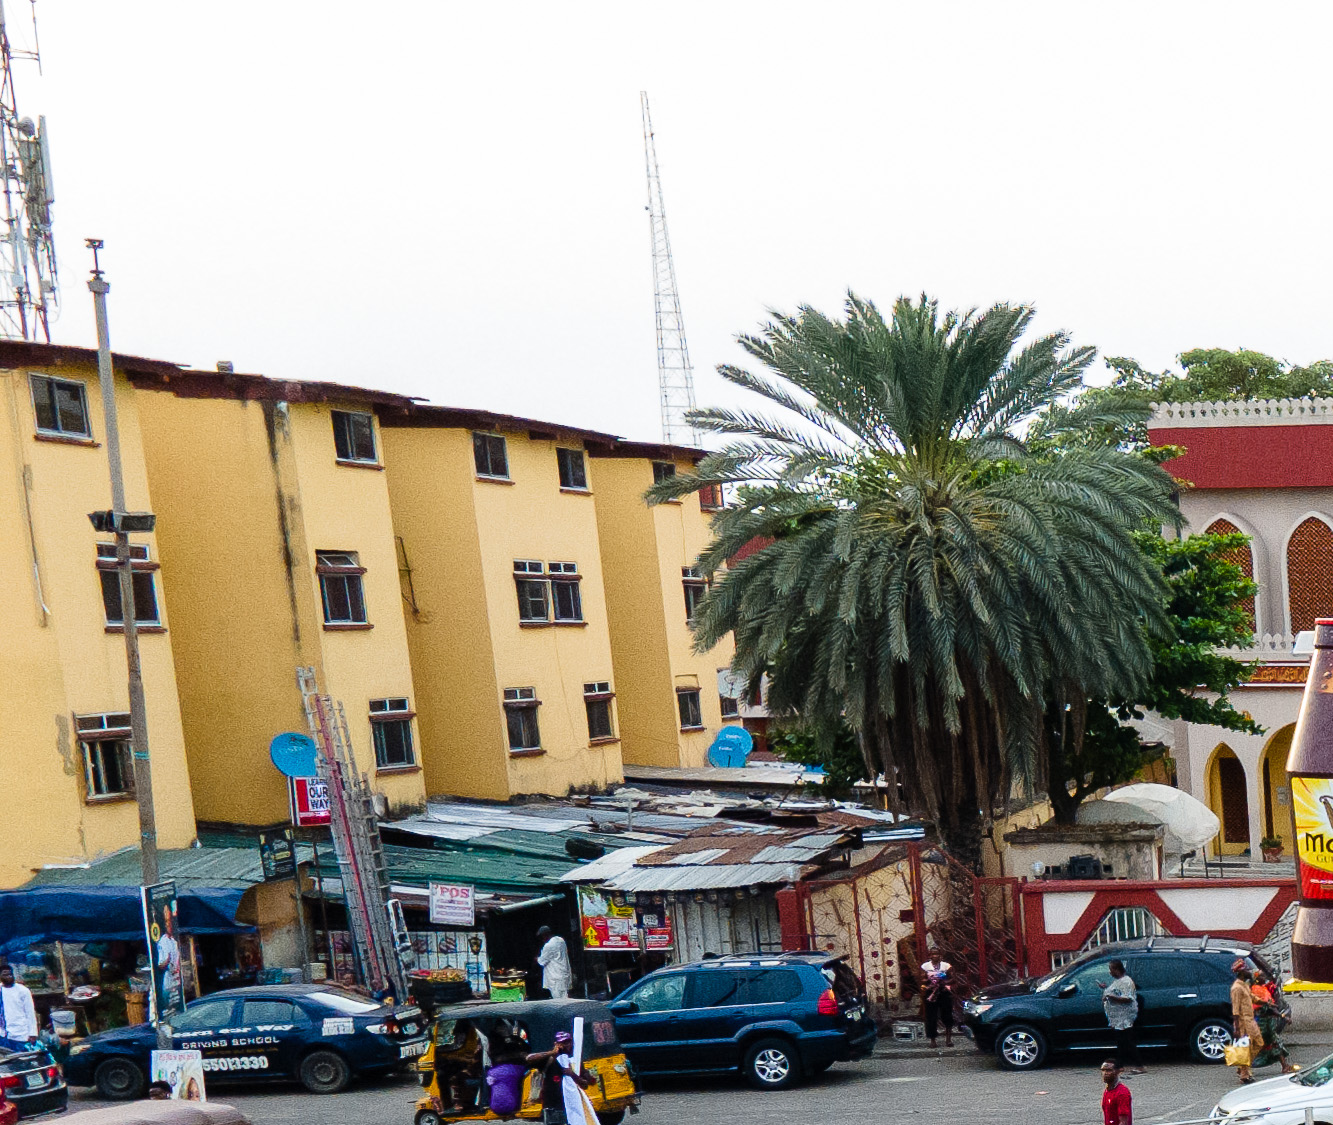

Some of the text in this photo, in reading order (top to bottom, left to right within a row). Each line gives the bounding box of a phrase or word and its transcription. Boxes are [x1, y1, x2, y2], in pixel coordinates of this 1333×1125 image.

[309, 786, 328, 799] OUR
[440, 886, 470, 898] POS
[181, 1036, 281, 1050] DRIVING SCHOOL
